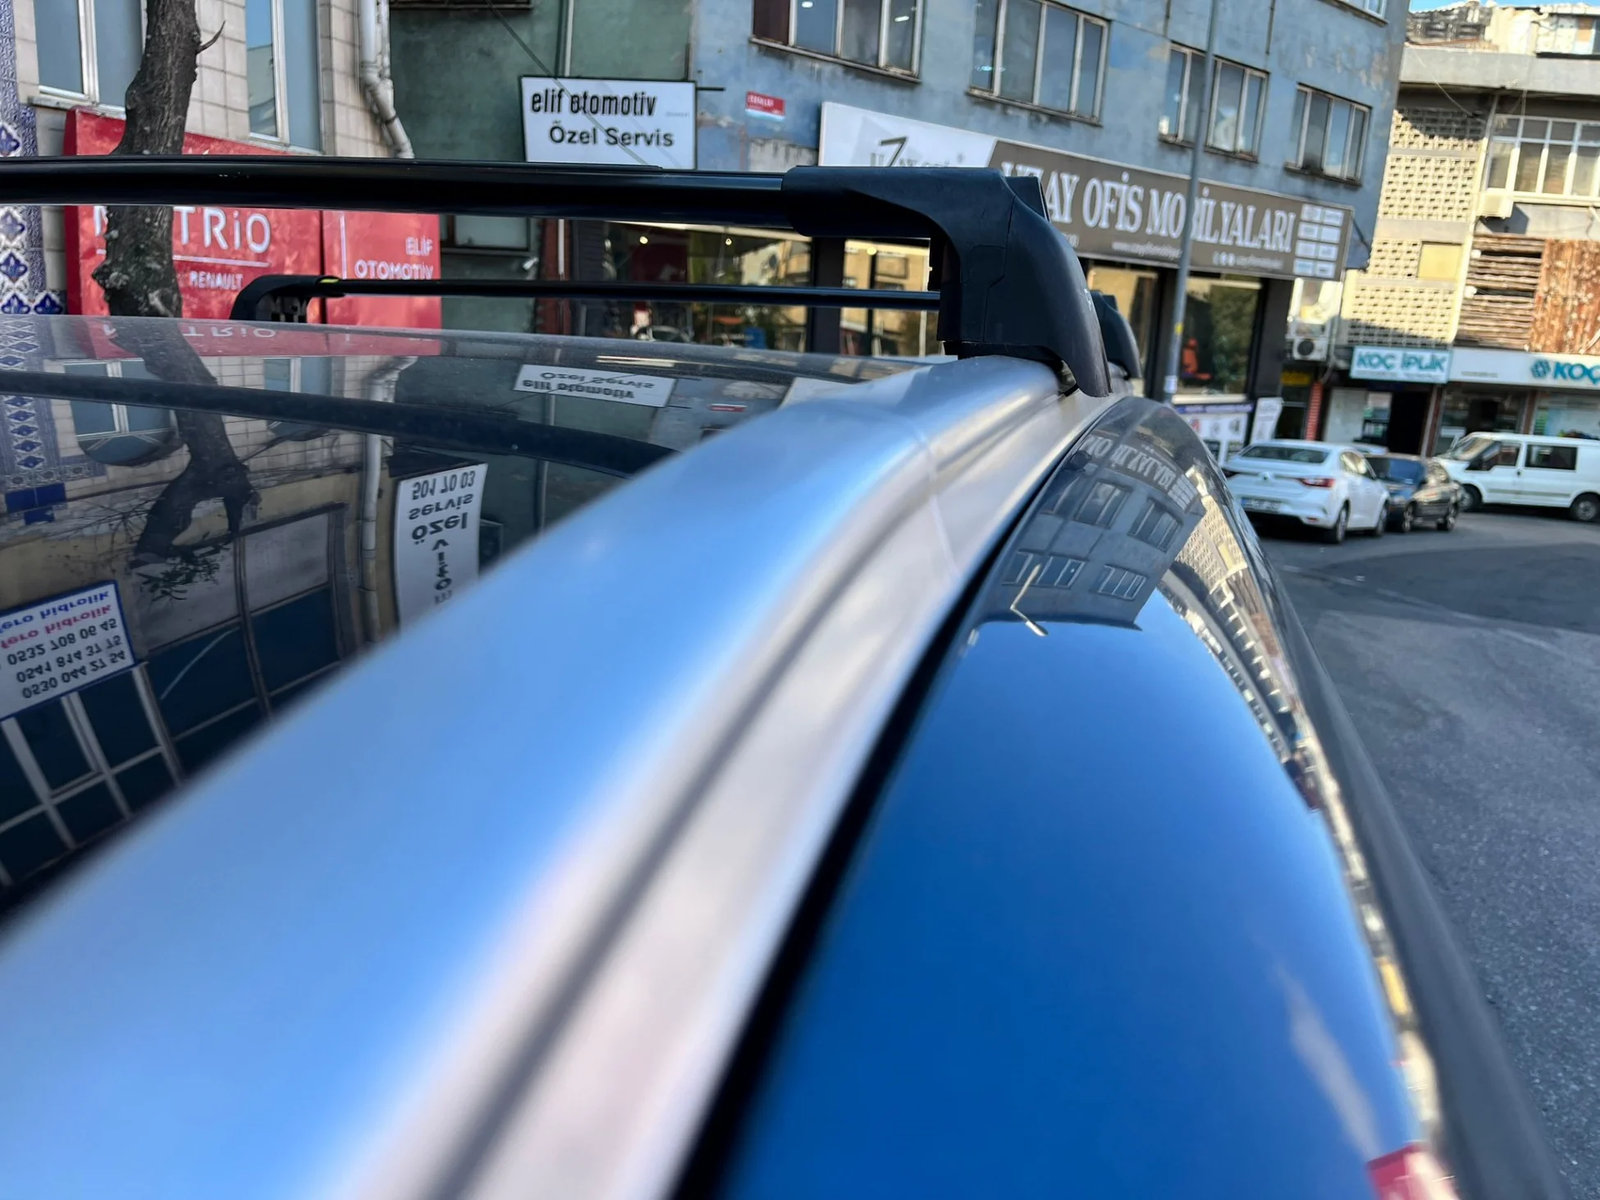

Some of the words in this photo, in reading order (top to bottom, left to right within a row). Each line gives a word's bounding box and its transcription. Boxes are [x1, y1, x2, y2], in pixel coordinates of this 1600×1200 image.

[531, 88, 565, 113] elif
[570, 90, 657, 117] otomotiv
[605, 126, 674, 147] Servis
[1083, 171, 1144, 233] OFİS
[405, 235, 433, 256] ELİF
[354, 259, 434, 279] OTOMOTİV
[189, 271, 243, 290] RENAULT
[1357, 352, 1396, 371] KOÇ
